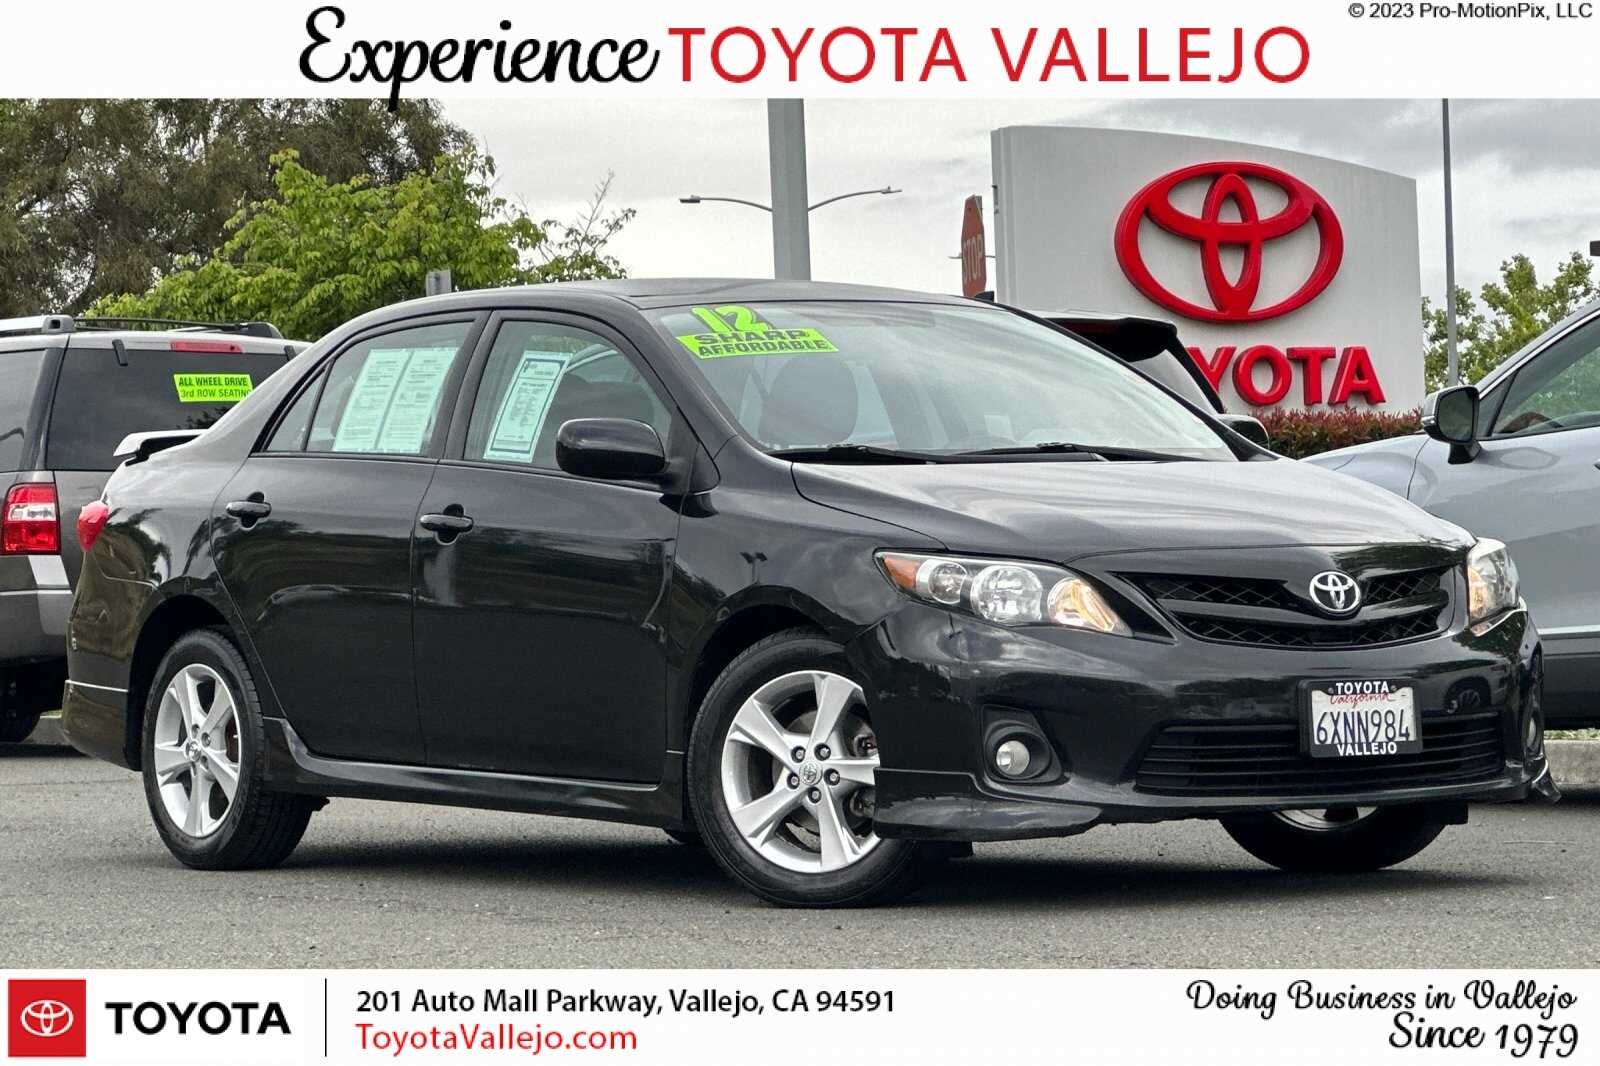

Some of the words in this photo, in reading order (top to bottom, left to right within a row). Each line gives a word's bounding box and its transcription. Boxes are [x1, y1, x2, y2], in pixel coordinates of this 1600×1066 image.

[963, 233, 984, 285] STOP
[691, 305, 770, 333] 12
[694, 329, 810, 344] SHARP
[699, 339, 829, 356] AFFORDABLE
[179, 376, 193, 387] ALL
[195, 376, 222, 387] WHEEL
[224, 376, 248, 387] DRIVE
[1185, 344, 1386, 406] YOTA
[181, 390, 194, 398] 3rd
[197, 389, 216, 398] ROW
[1335, 680, 1390, 695] TOYOTA
[1316, 708, 1410, 745] 6XNN984
[1336, 741, 1398, 757] VALLEJO
